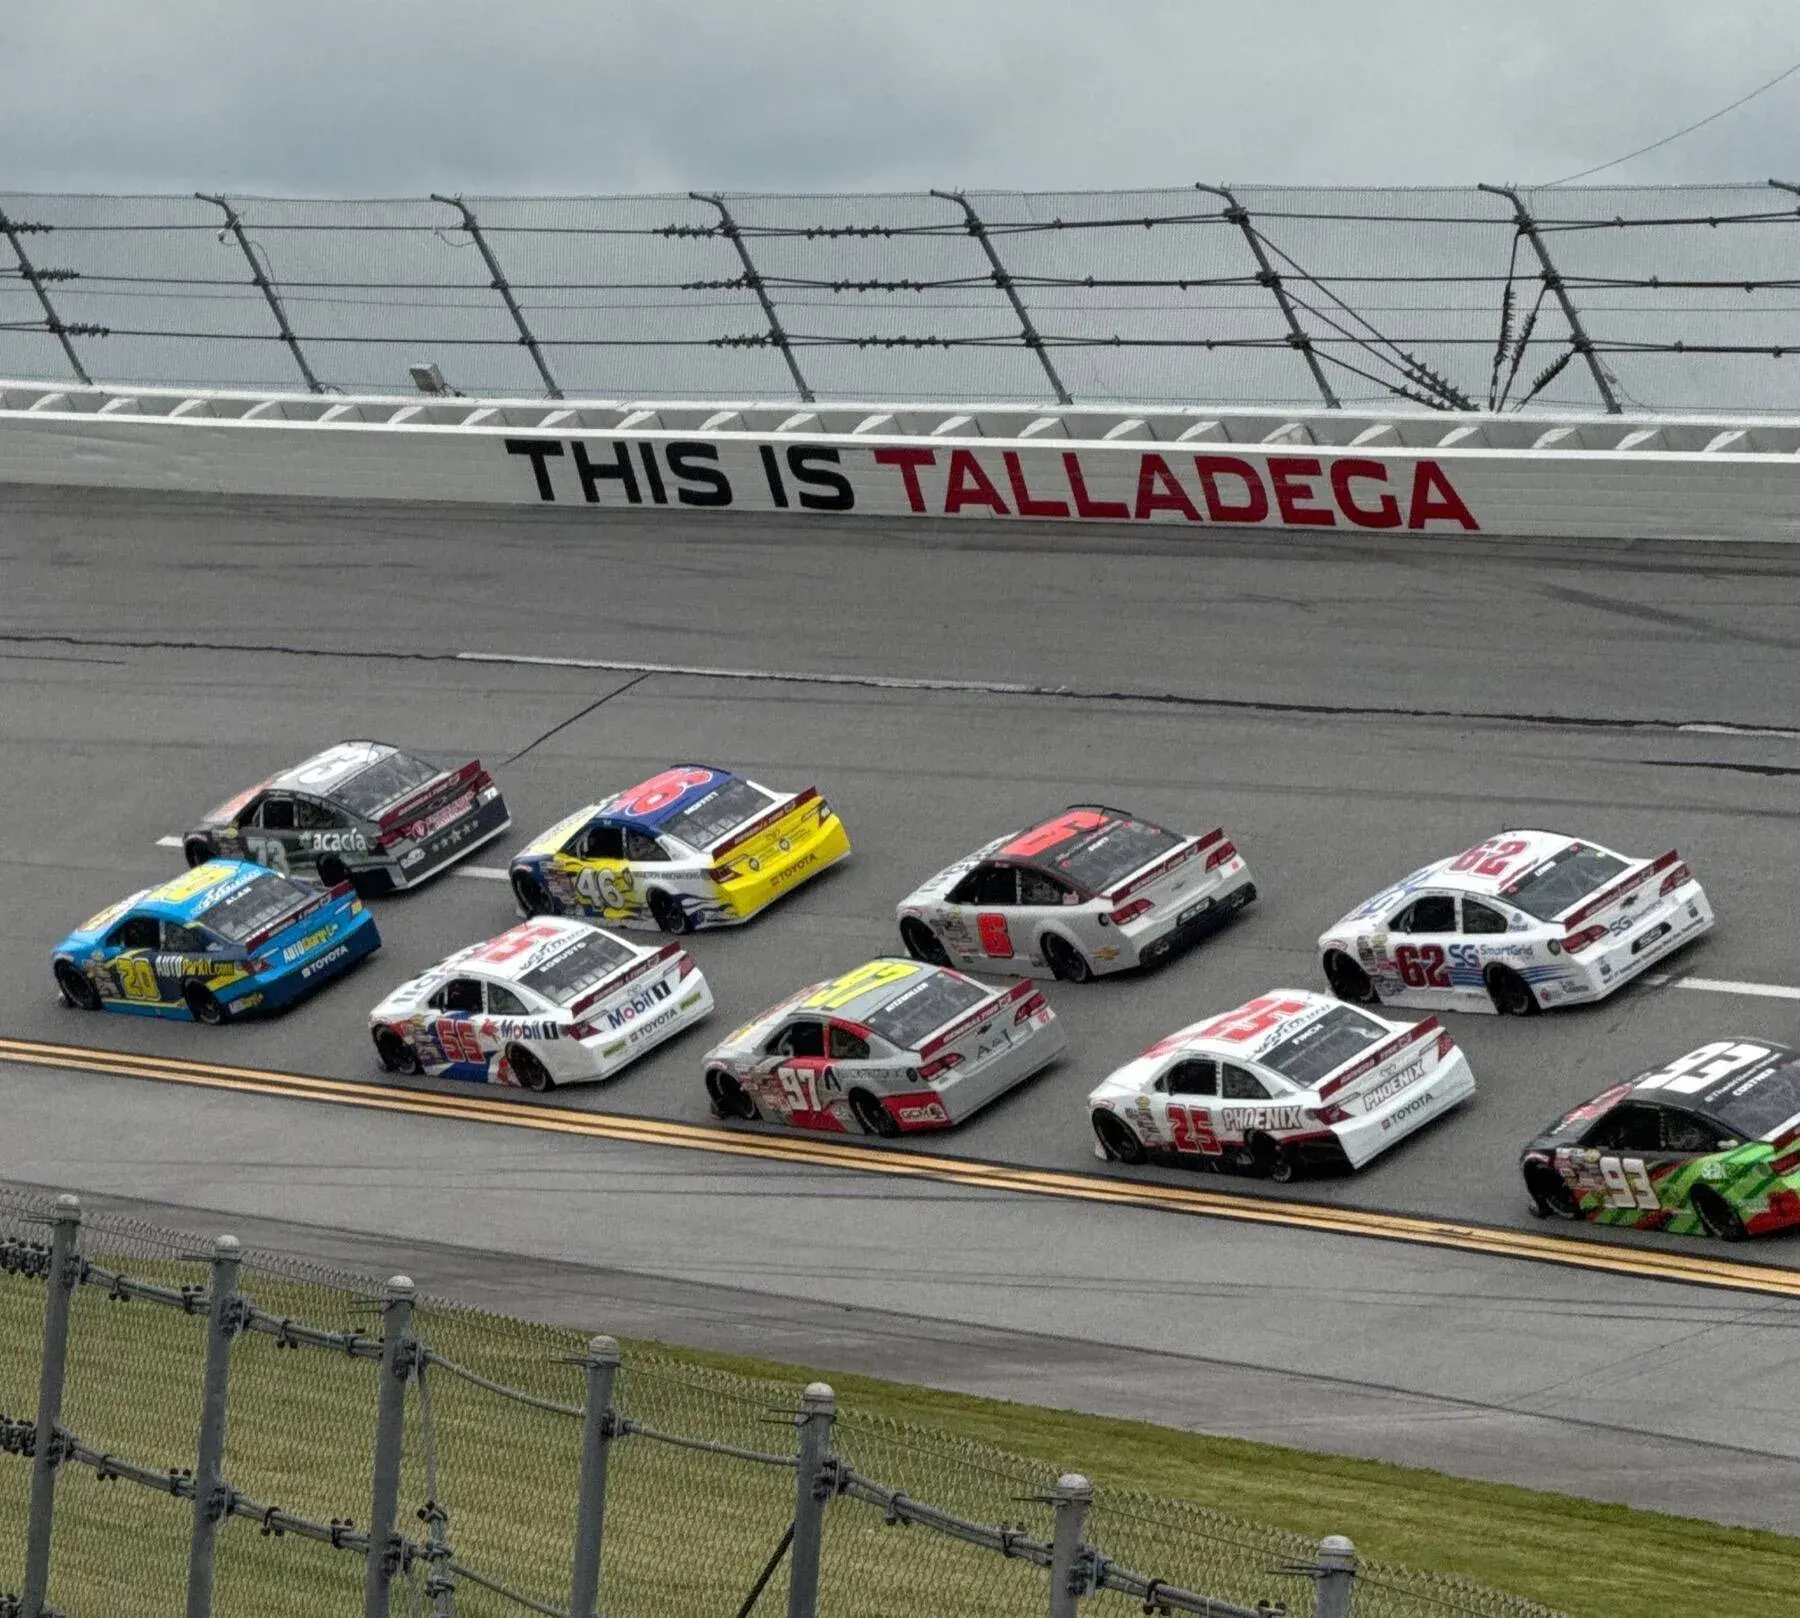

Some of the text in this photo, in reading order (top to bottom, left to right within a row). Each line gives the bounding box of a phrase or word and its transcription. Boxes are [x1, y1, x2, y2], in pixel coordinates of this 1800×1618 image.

[504, 439, 1481, 530] THIS IS TALLADEGA
[780, 853, 817, 881] TOYOTA
[1447, 839, 1530, 878] 62
[576, 867, 624, 909] 46
[309, 944, 349, 973] TOYOTA
[1394, 942, 1453, 989] 62
[1448, 944, 1479, 968] SG
[116, 957, 162, 1001] 20
[607, 988, 655, 1030] Mobil
[652, 980, 672, 1001] 1
[639, 1008, 678, 1037] TOYOTA
[435, 1018, 487, 1064] 55
[501, 1019, 560, 1041] Mobil 1
[777, 1067, 822, 1112] 97
[1362, 1058, 1425, 1112] PHOENIX
[1633, 1041, 1771, 1094] 93
[1165, 1103, 1223, 1156] 25
[1222, 1104, 1305, 1131] PHOENIX
[1391, 1092, 1434, 1124] TOYOTA
[1600, 1157, 1662, 1210] 93
